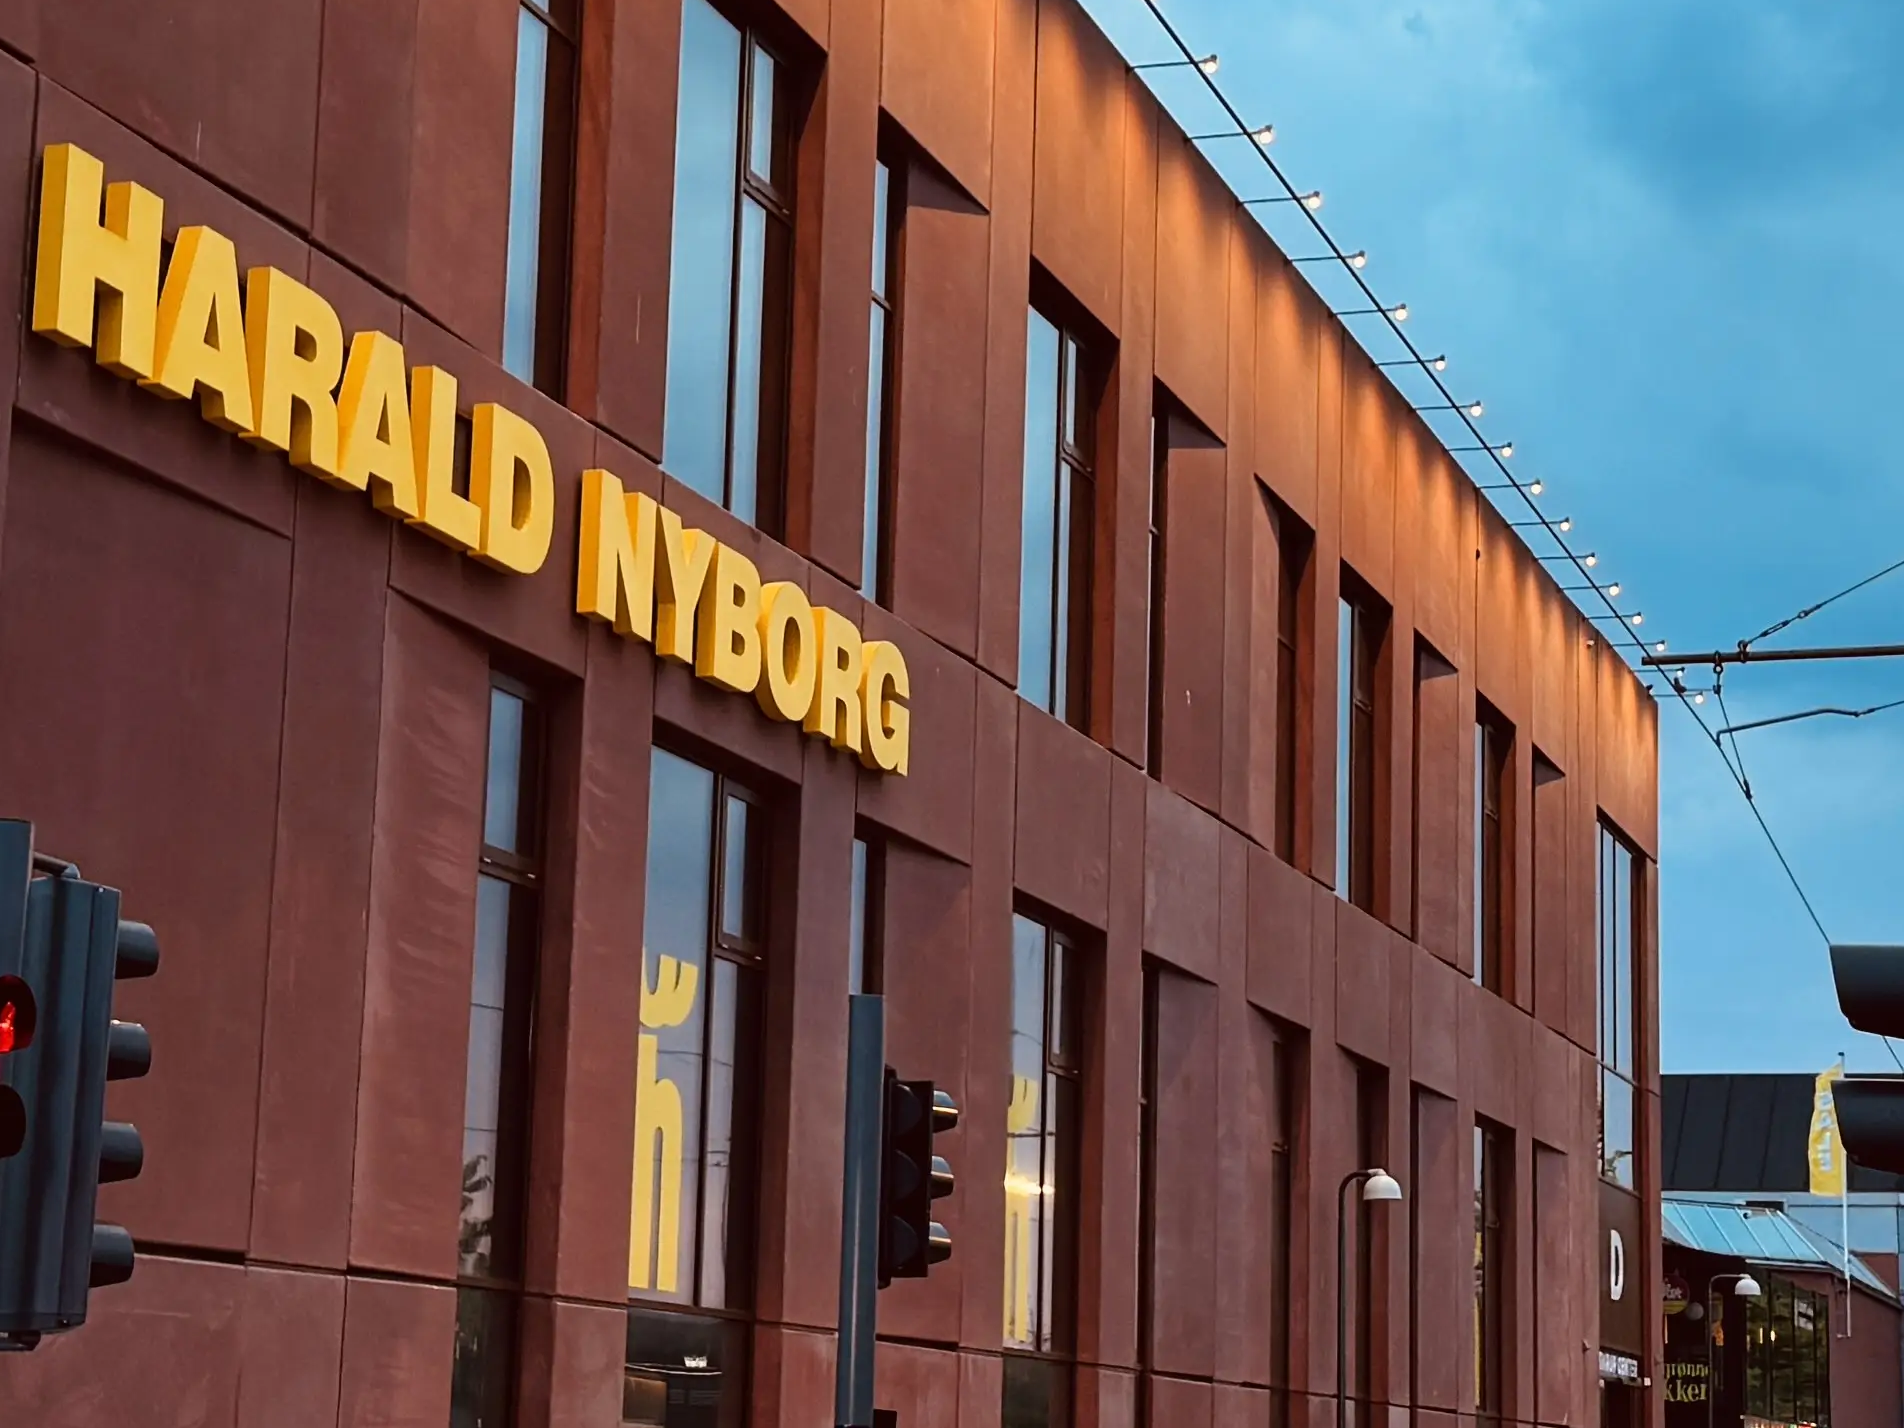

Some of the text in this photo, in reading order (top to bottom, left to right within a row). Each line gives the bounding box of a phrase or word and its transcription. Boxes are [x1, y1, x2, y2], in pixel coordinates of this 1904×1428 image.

[32, 143, 910, 777] HARALD NYBORG
[1610, 1228, 1624, 1301] D
